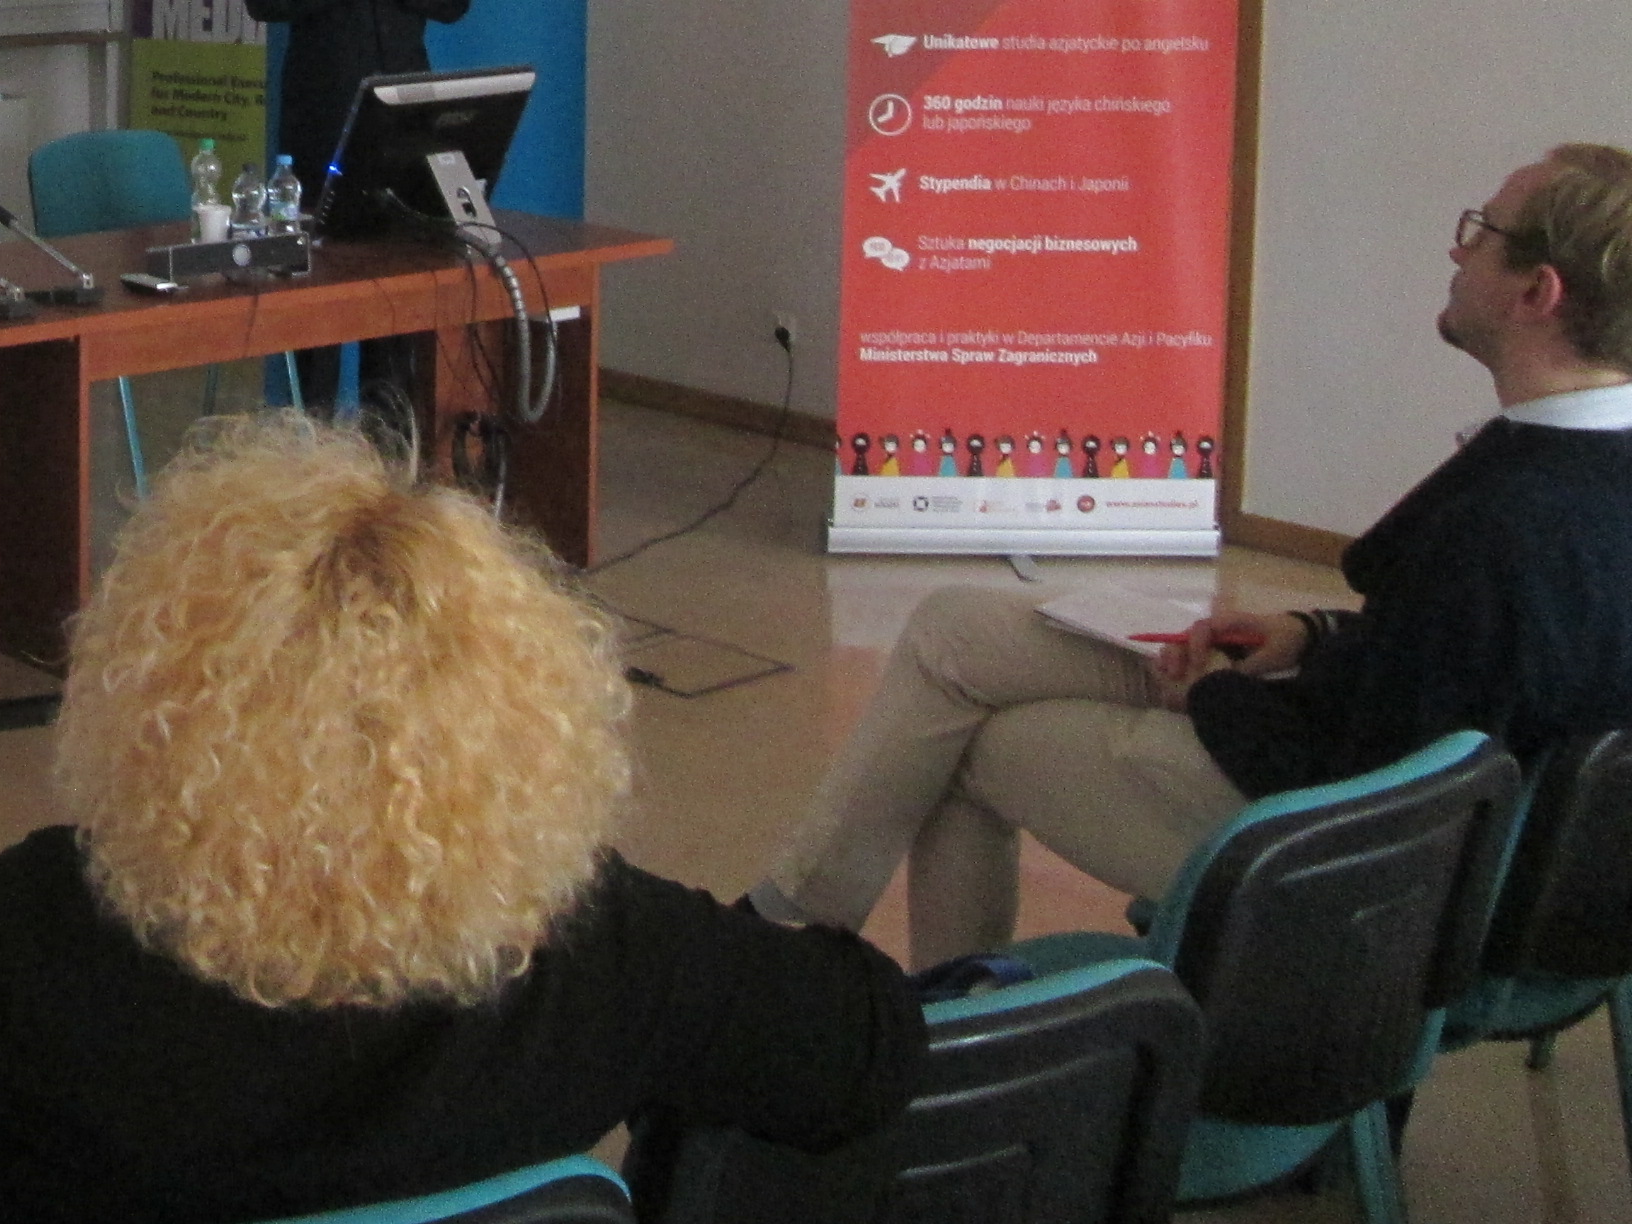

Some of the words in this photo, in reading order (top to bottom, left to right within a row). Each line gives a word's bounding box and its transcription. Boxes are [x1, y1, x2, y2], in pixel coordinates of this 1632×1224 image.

[923, 34, 999, 50] Unikatowe
[1002, 35, 1045, 50] studia
[1049, 35, 1118, 53] azjatyckie
[1122, 40, 1141, 52] po
[1143, 36, 1209, 54] angielsku
[955, 95, 1003, 113] godzin
[1006, 96, 1044, 111] nauki
[923, 116, 945, 130] lub
[920, 175, 991, 194] Stypendia
[995, 180, 1006, 190] w
[1010, 175, 1066, 191] Chinach
[1077, 176, 1130, 194] Japonii
[918, 235, 965, 252] Sztuka
[968, 236, 1042, 255] negocjacji
[1045, 236, 1138, 255] biznesowych
[947, 332, 999, 347] praktyki
[1003, 335, 1013, 345] w
[1018, 331, 1118, 347] Departamencie
[859, 347, 948, 363] Ministerstwa
[952, 348, 994, 364] Spraw
[998, 349, 1097, 366] Zagranicznych
